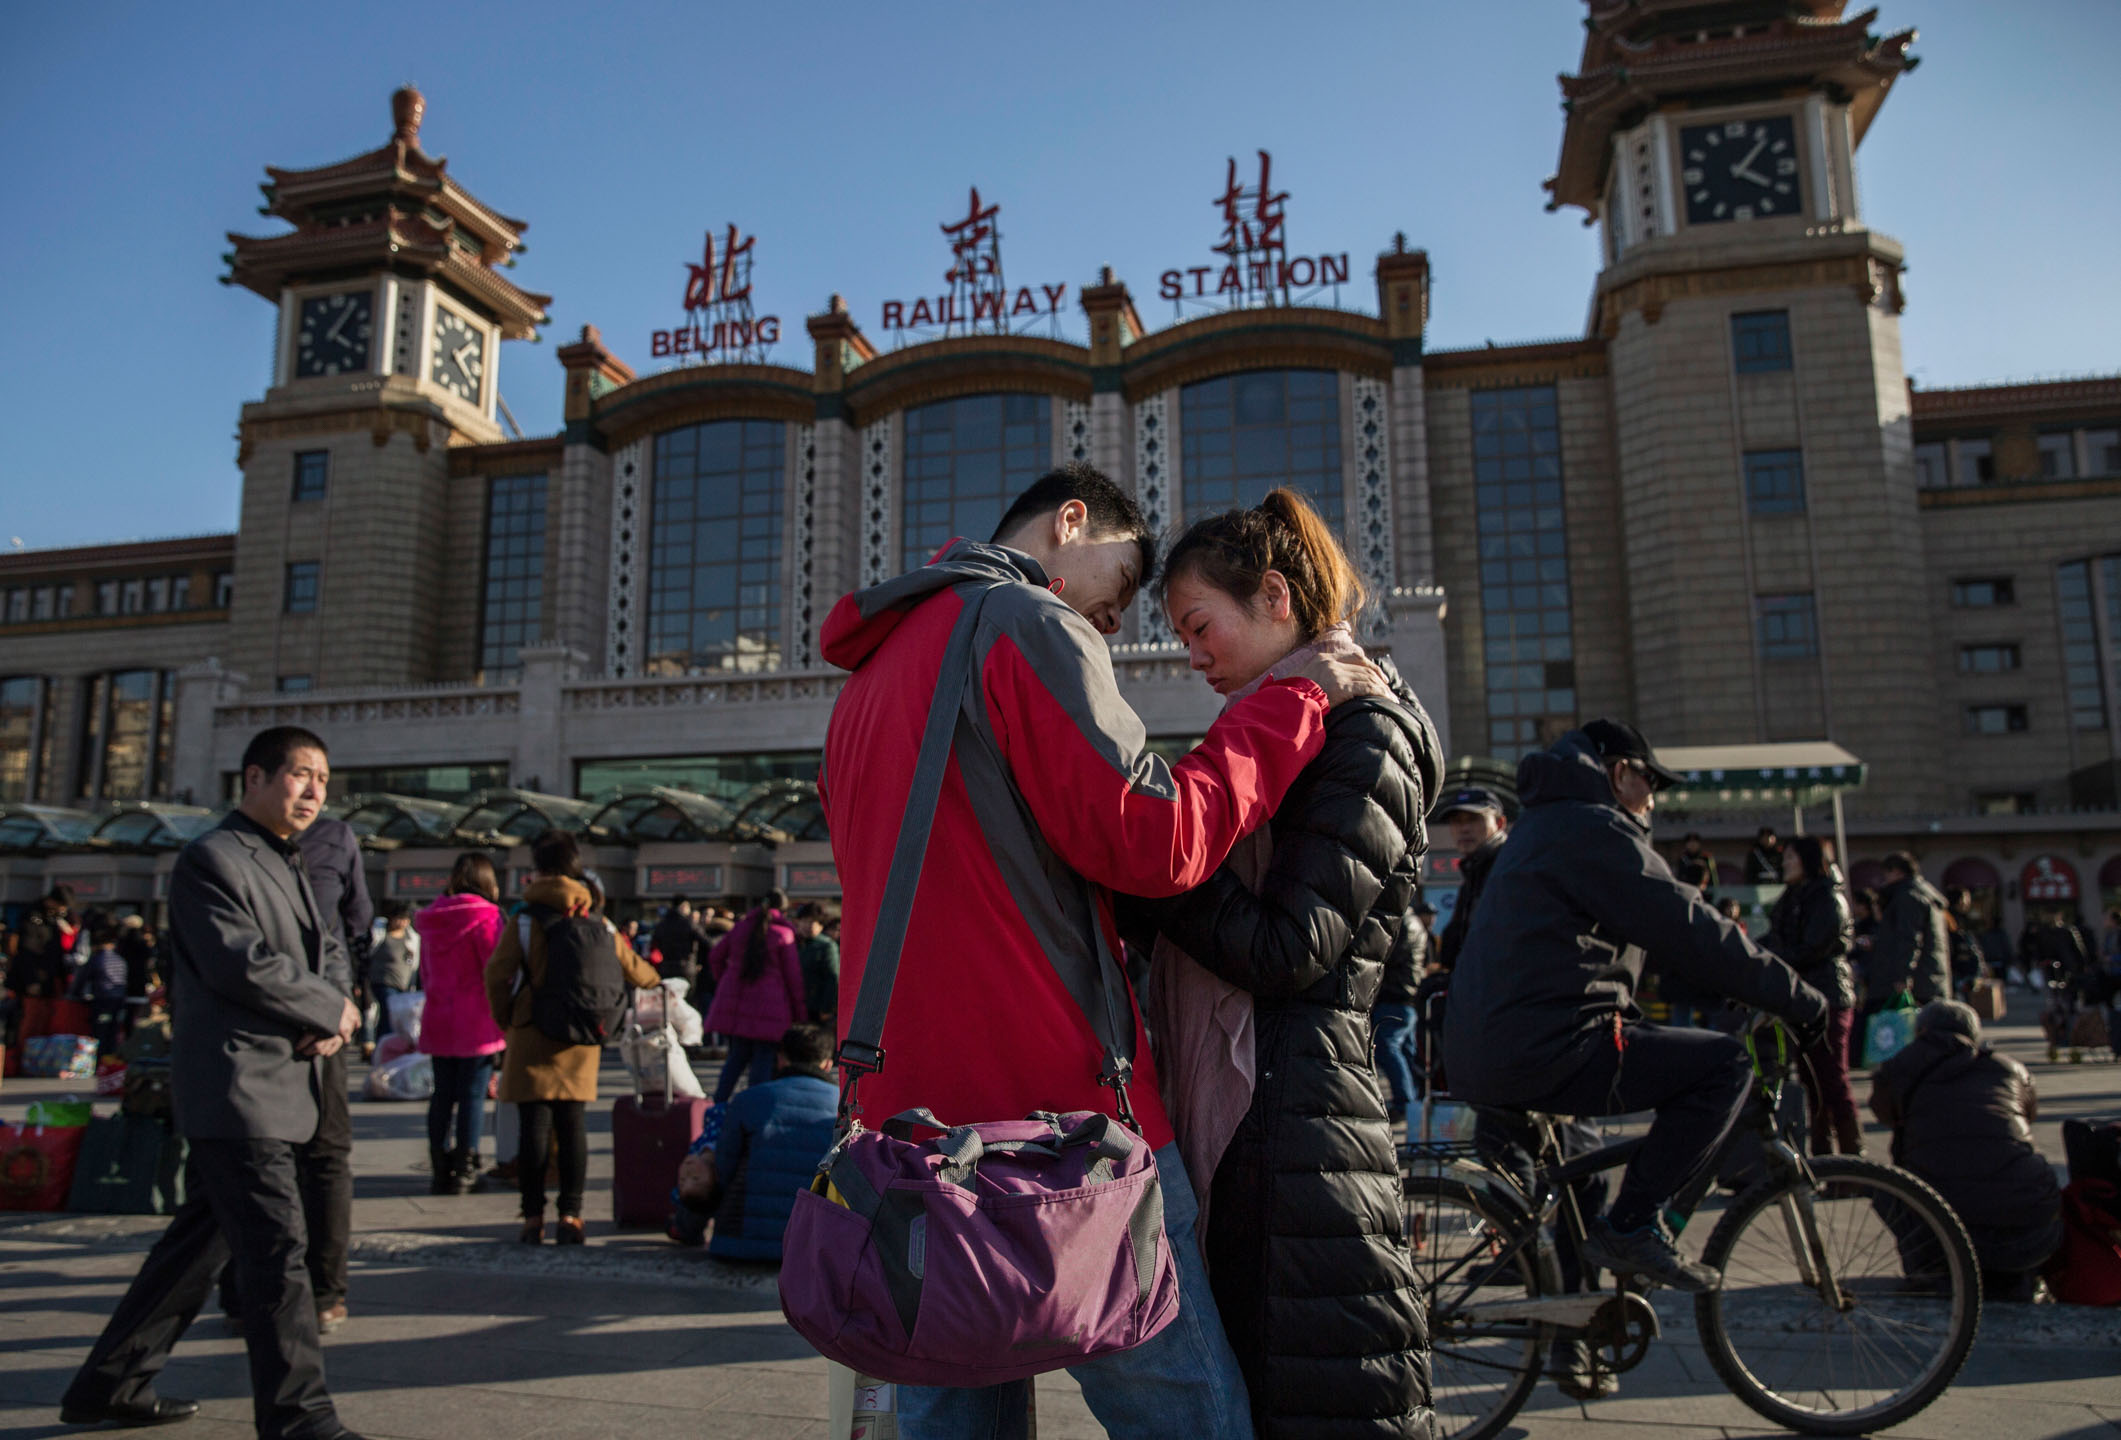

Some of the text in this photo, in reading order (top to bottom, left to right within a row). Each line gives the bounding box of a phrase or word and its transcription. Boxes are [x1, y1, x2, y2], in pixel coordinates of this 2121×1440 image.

[683, 149, 1289, 311] 北 京 站
[652, 252, 1348, 358] BEIJING RAILWAY STATION
